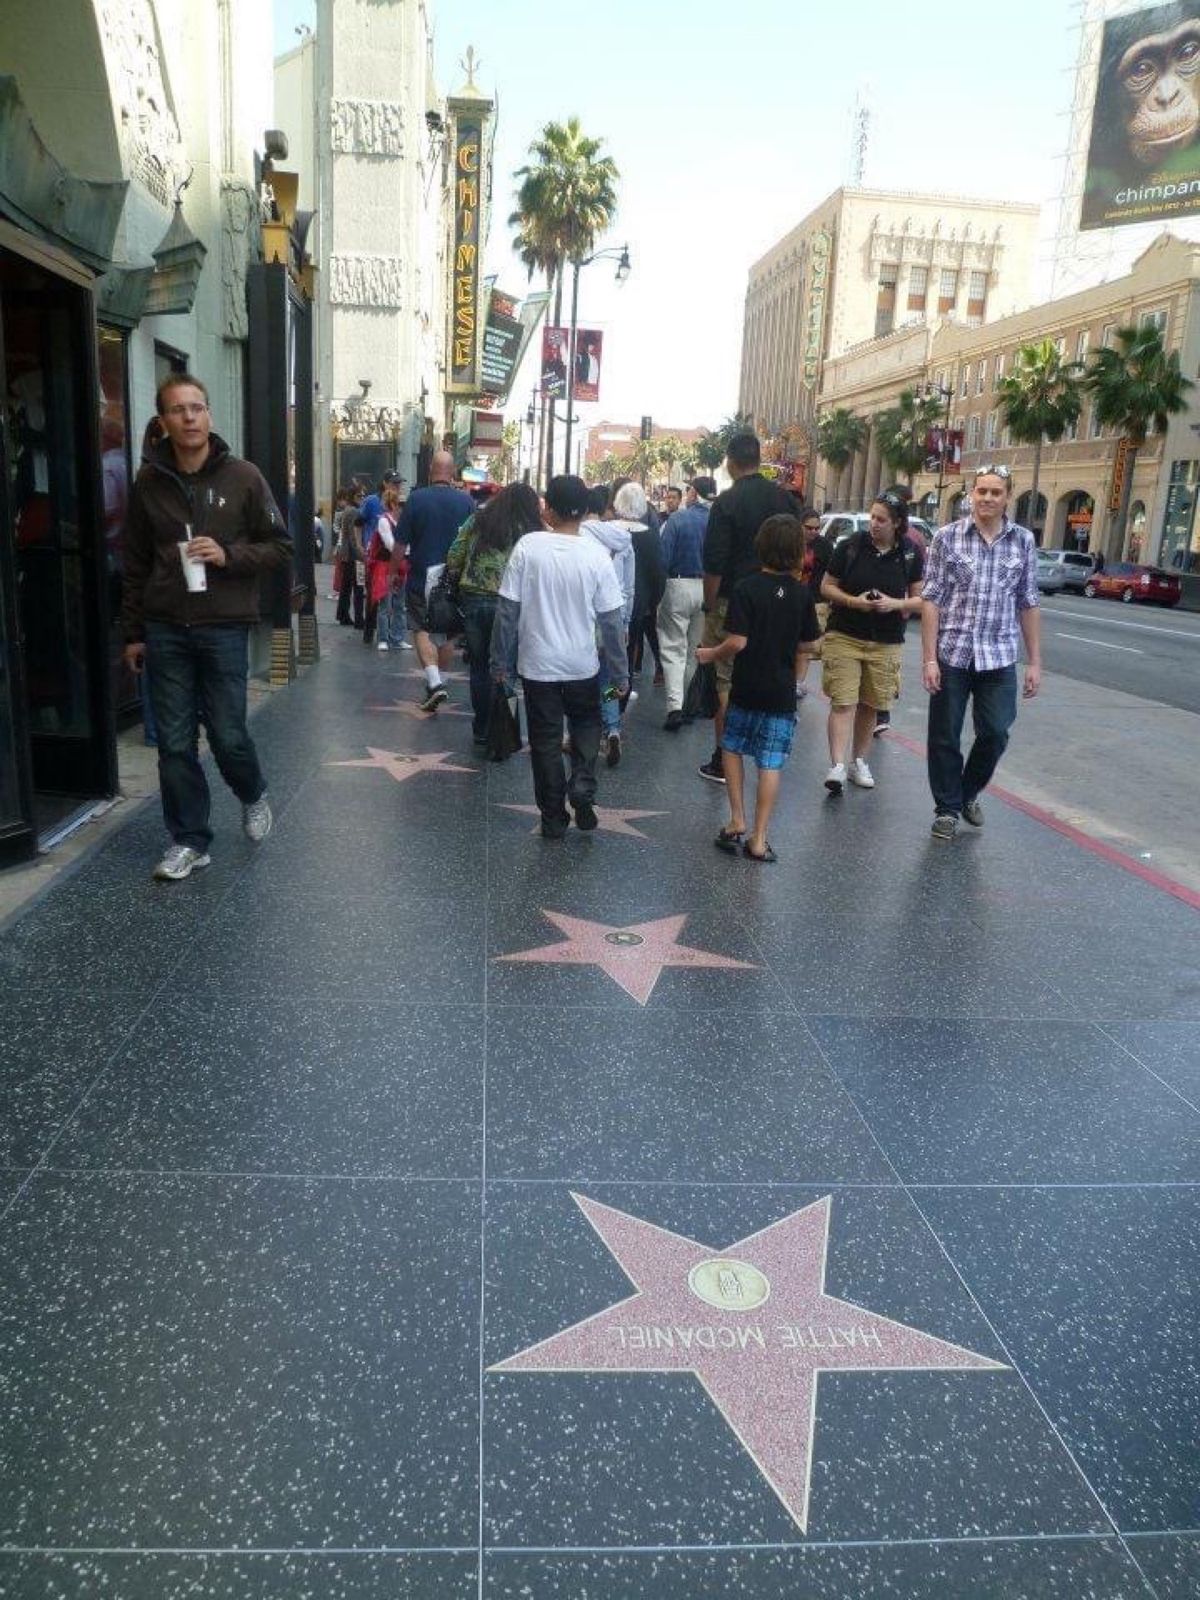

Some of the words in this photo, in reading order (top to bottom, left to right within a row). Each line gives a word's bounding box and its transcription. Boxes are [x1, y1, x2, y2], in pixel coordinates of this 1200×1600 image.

[1115, 179, 1200, 205] chimpan
[607, 1325, 767, 1350] MCDANIEL
[779, 1323, 883, 1349] HATTIE
